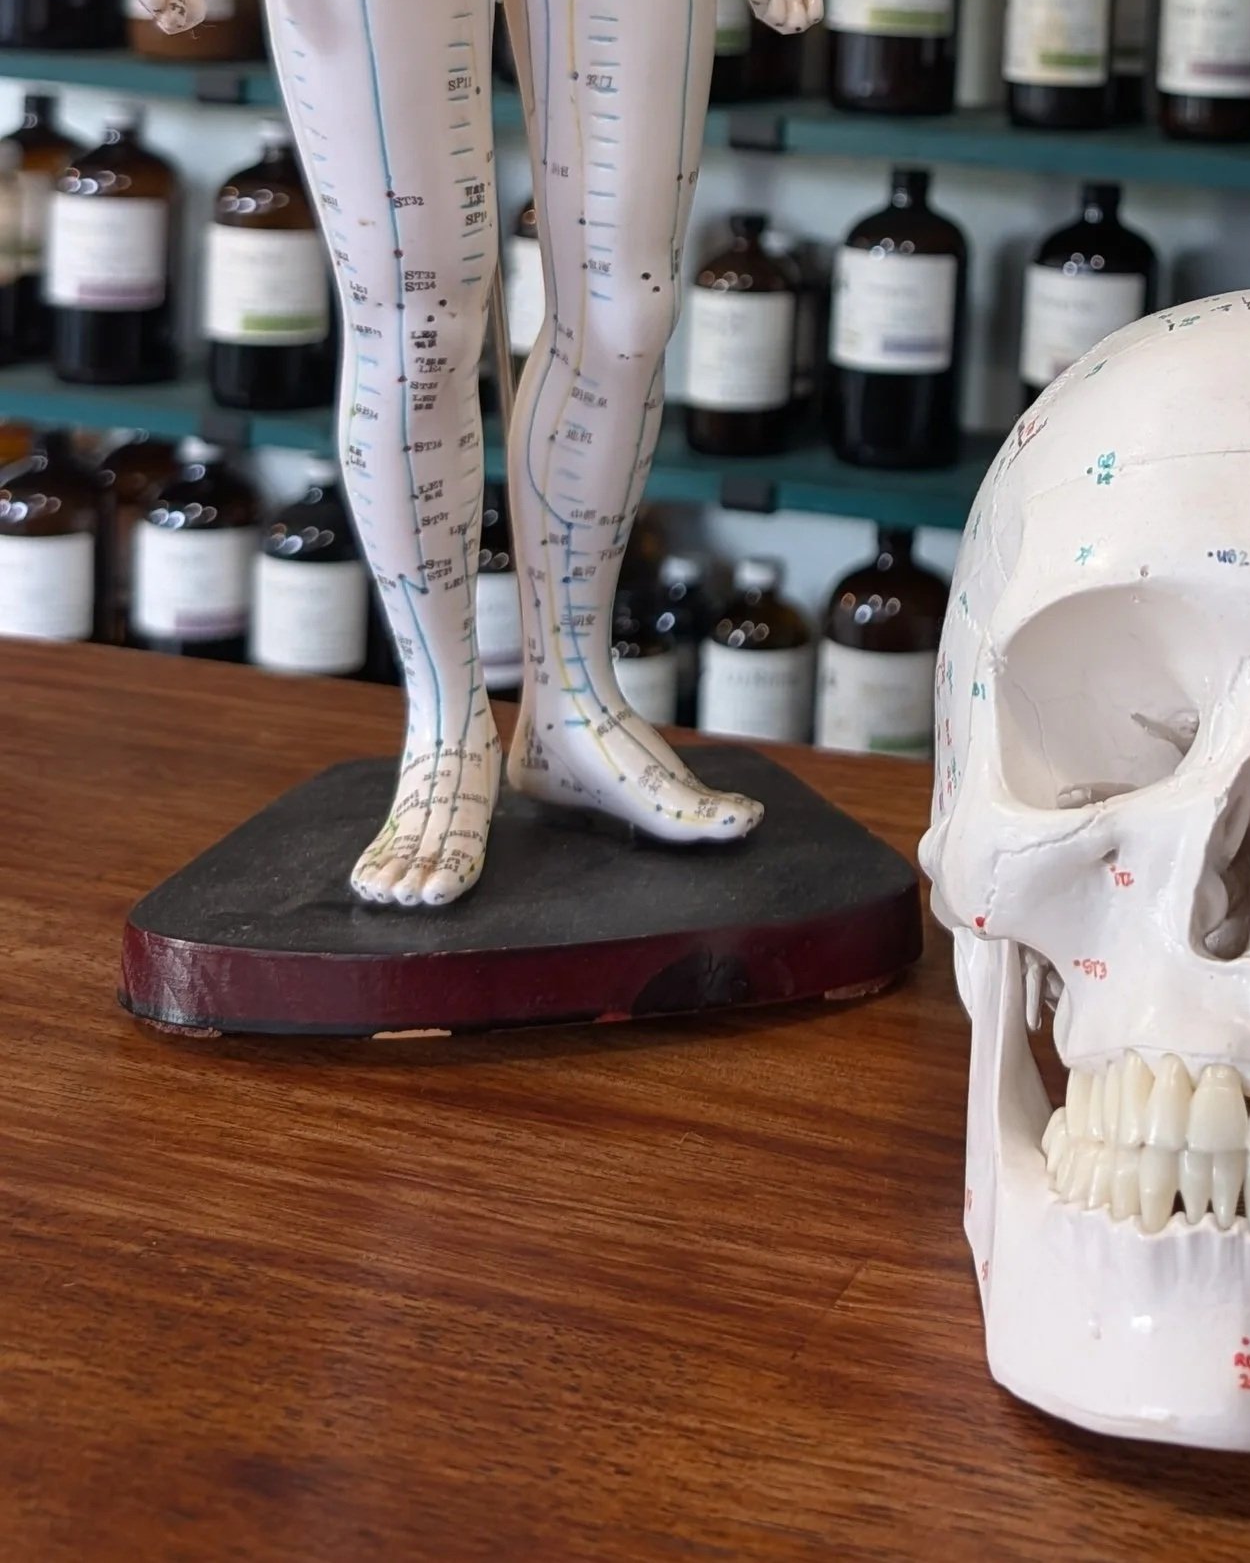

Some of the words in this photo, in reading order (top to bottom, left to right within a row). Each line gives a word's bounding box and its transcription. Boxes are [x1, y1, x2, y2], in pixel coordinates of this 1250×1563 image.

[394, 196, 424, 209] ST32
[404, 270, 436, 283] ST33
[1082, 958, 1108, 980] ST3
